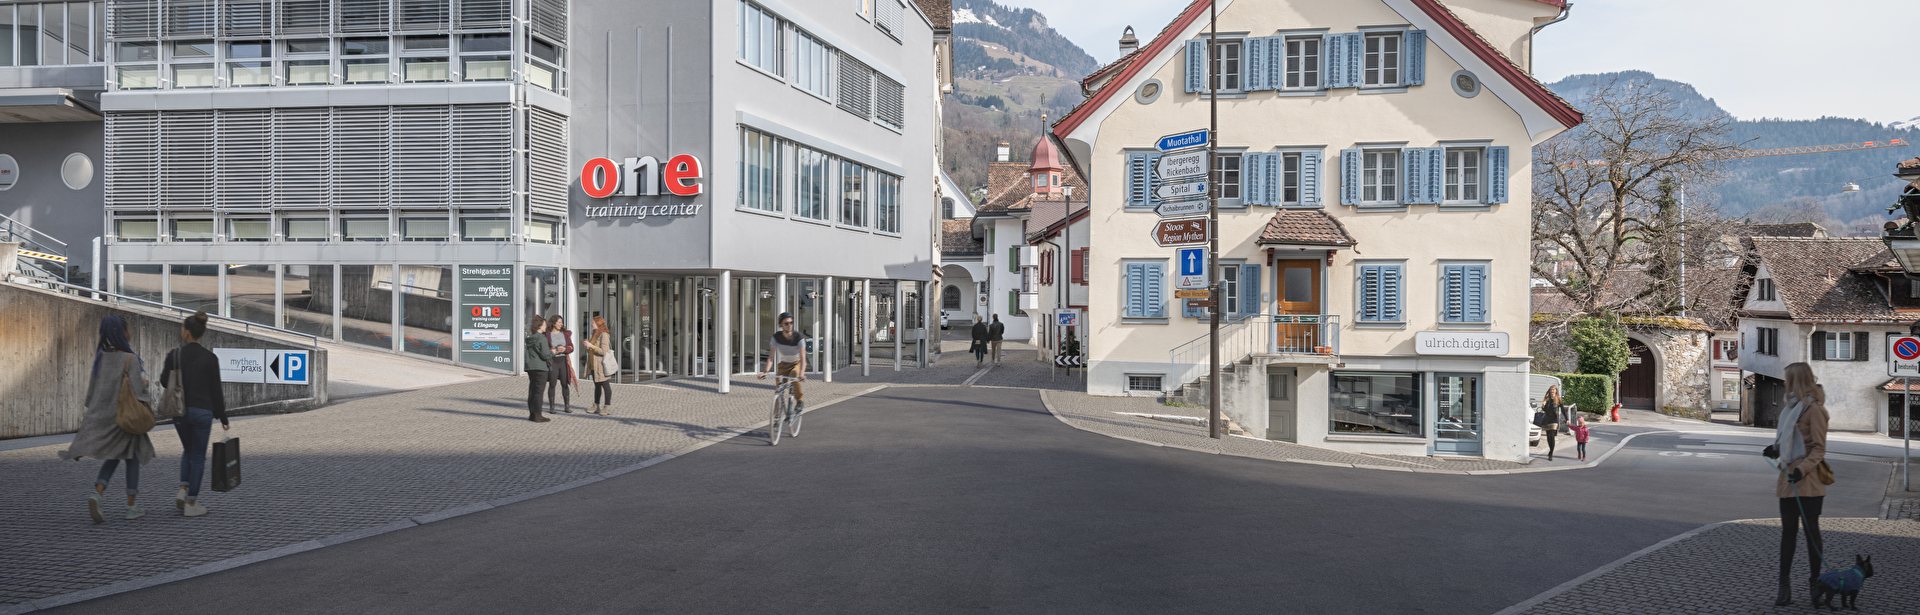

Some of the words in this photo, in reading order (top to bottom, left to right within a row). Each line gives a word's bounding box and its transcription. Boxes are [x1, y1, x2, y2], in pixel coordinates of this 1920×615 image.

[1167, 134, 1202, 148] Muotathal
[1166, 155, 1200, 166] Ibergeregg
[580, 153, 703, 198] one
[1166, 165, 1200, 177] Rickenbach
[1171, 184, 1190, 195] Spital
[585, 203, 647, 220] training
[652, 203, 703, 216] center
[1164, 222, 1184, 232] Stoos
[1163, 233, 1182, 244] Region
[1182, 232, 1204, 243] Mythen
[462, 268, 501, 276] Strehlgasse
[488, 290, 508, 298] praxis
[471, 306, 501, 317] one
[1425, 337, 1499, 351] ulrich.digital
[241, 364, 262, 374] praxis
[288, 356, 302, 378] P
[1898, 364, 1917, 372] beidseitig
